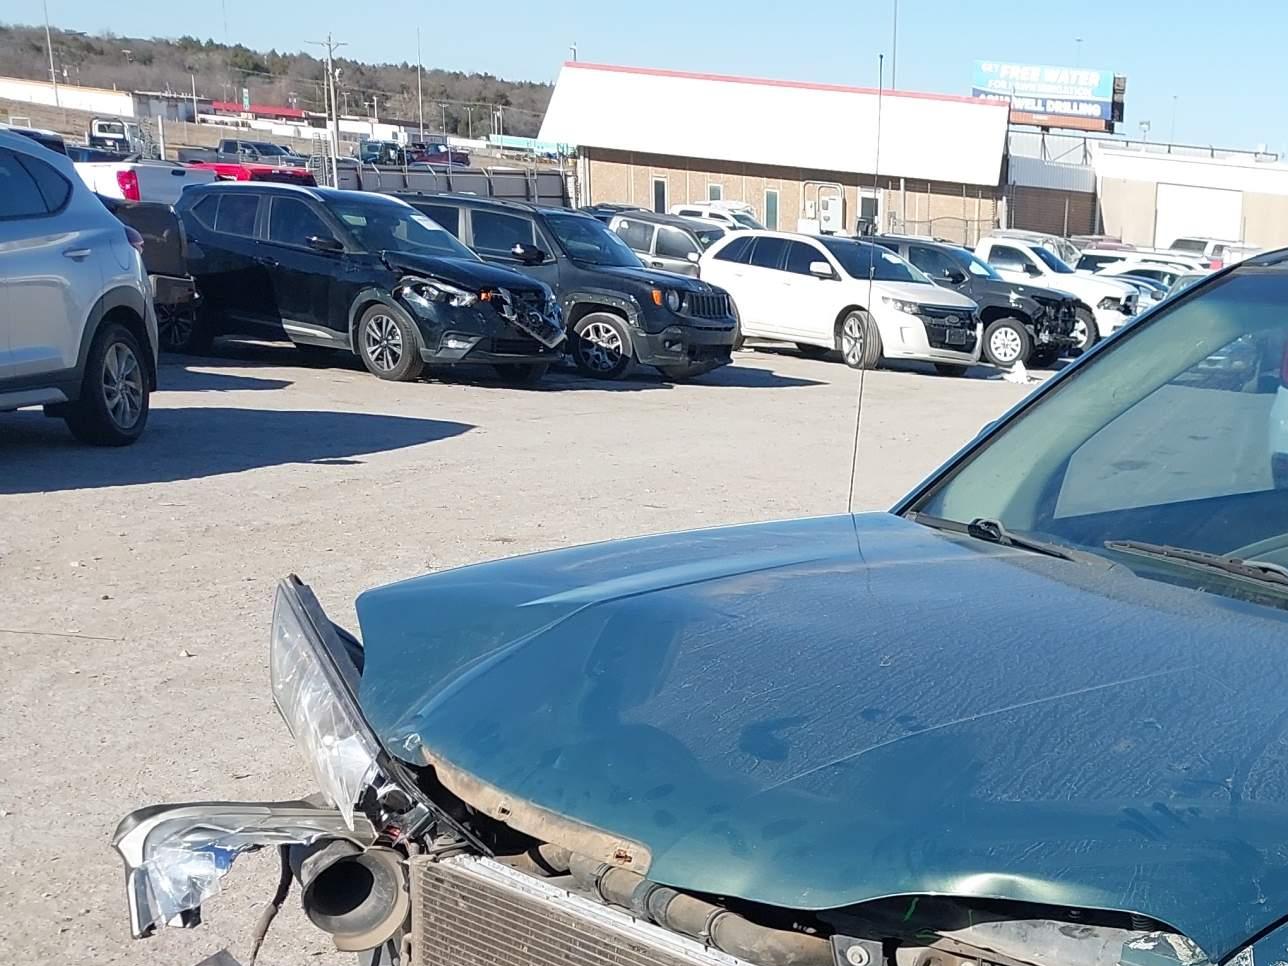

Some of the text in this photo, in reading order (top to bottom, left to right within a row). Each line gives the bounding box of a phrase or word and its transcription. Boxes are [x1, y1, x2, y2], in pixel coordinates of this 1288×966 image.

[1000, 64, 1040, 82] FREE
[1044, 68, 1100, 87] WATER
[1011, 98, 1045, 111] WELL
[1046, 100, 1101, 116] DRILLING
